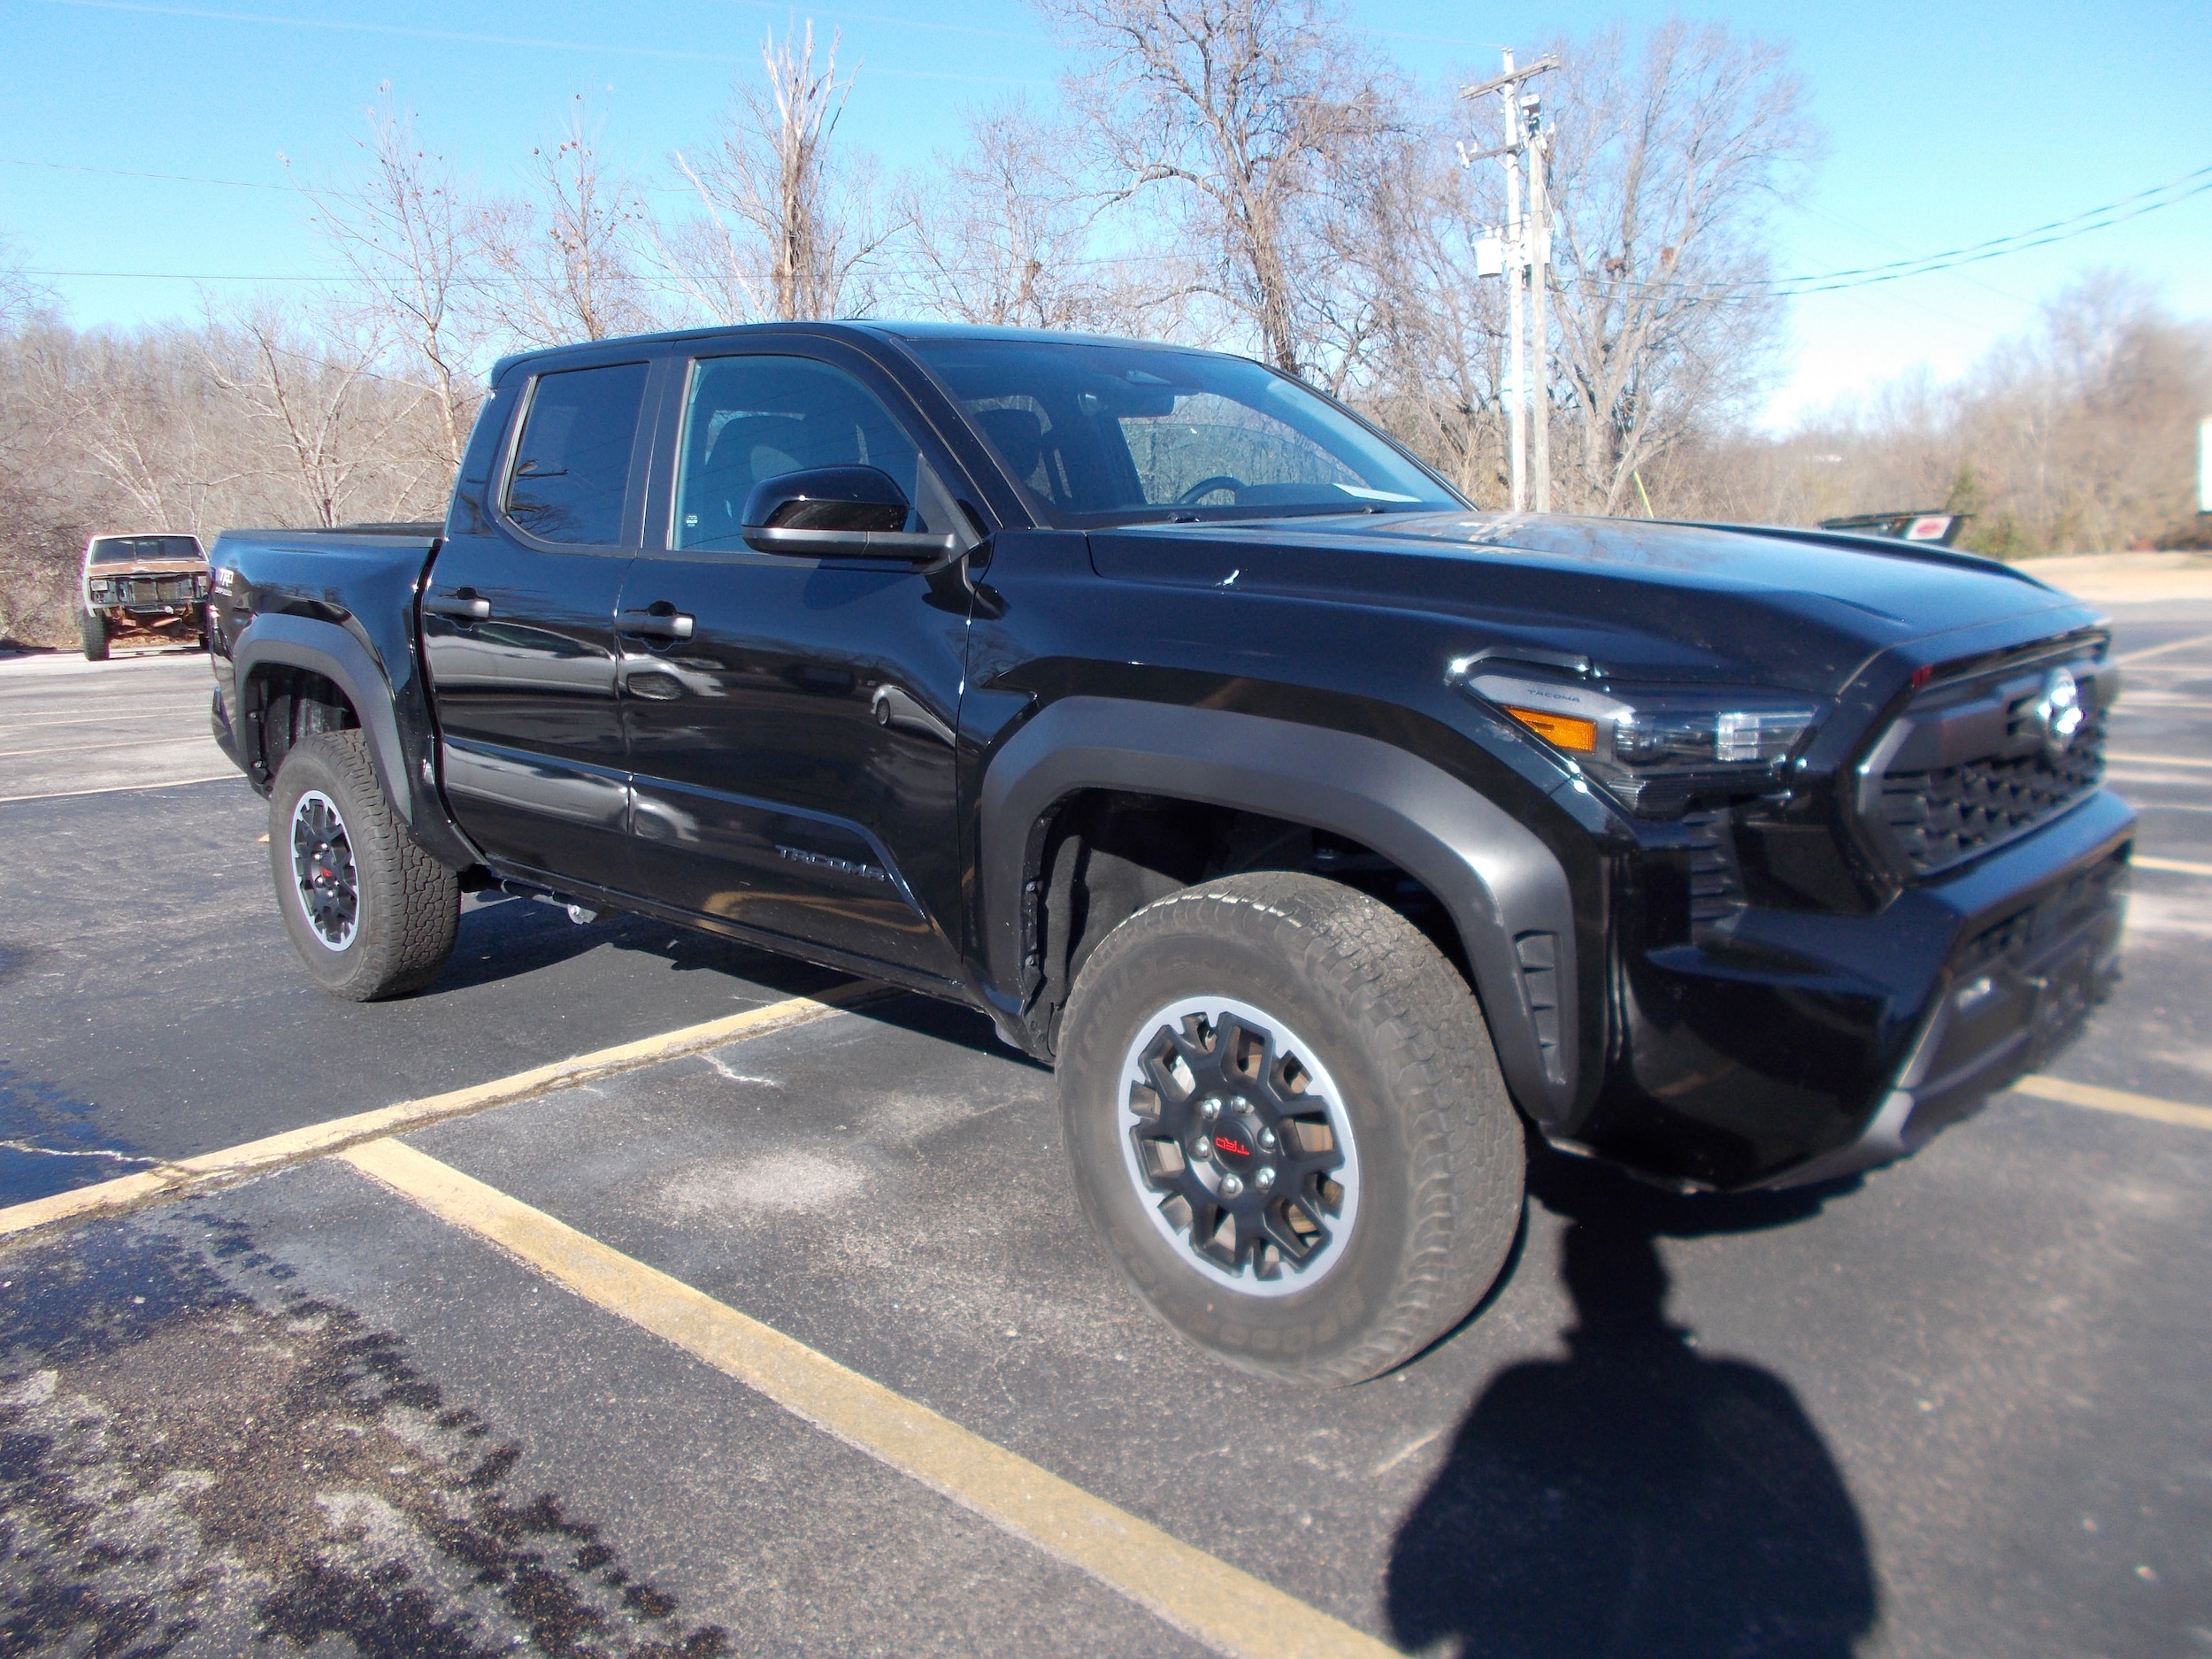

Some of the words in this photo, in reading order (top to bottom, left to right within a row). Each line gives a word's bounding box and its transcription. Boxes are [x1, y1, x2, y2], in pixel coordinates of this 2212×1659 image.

[219, 568, 234, 587] TRD
[1527, 689, 1580, 703] TACOMA
[774, 844, 886, 881] TACOMA
[1215, 1136, 1250, 1156] TRD
